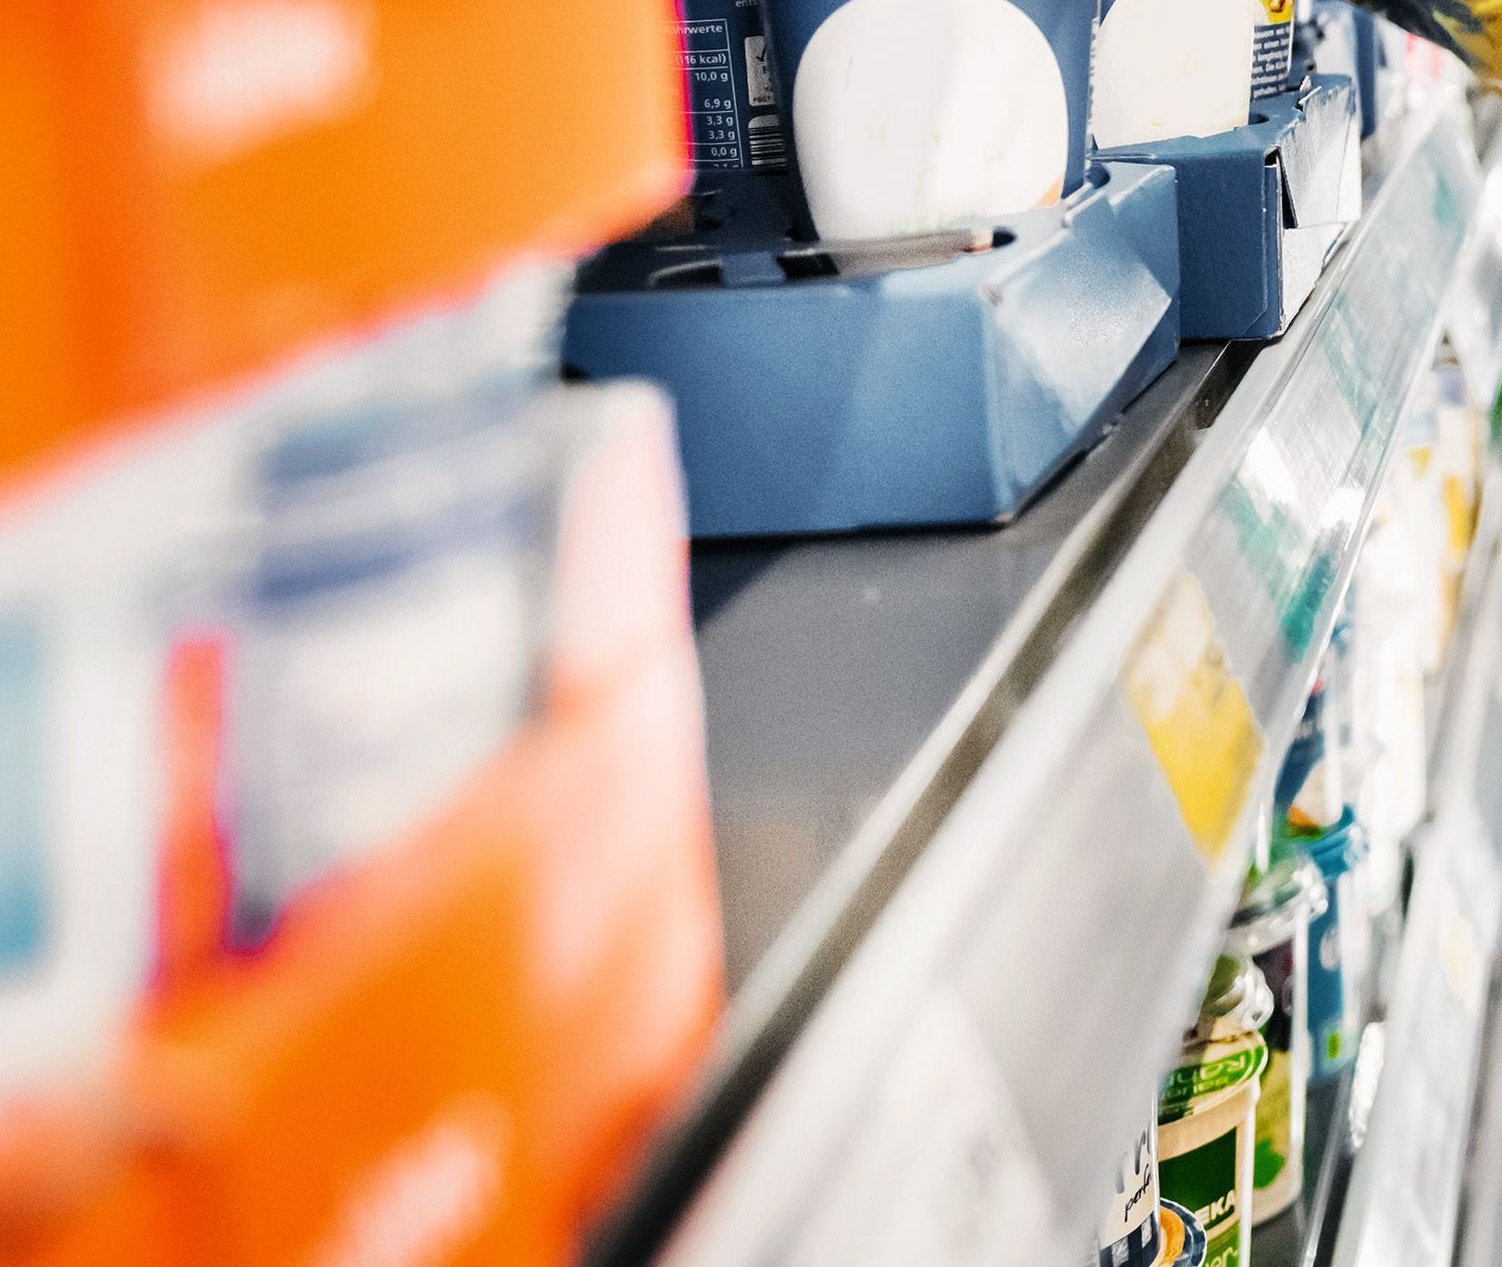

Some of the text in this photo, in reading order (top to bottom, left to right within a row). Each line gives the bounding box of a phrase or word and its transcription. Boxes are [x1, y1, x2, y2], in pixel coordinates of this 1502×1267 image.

[699, 53, 727, 65] kcal)
[695, 71, 729, 83] 10,0 g
[704, 99, 732, 110] 6,9 g
[706, 115, 734, 127] 3,3 g
[709, 130, 736, 141] 3,3 g
[711, 147, 738, 158] 0,0 g
